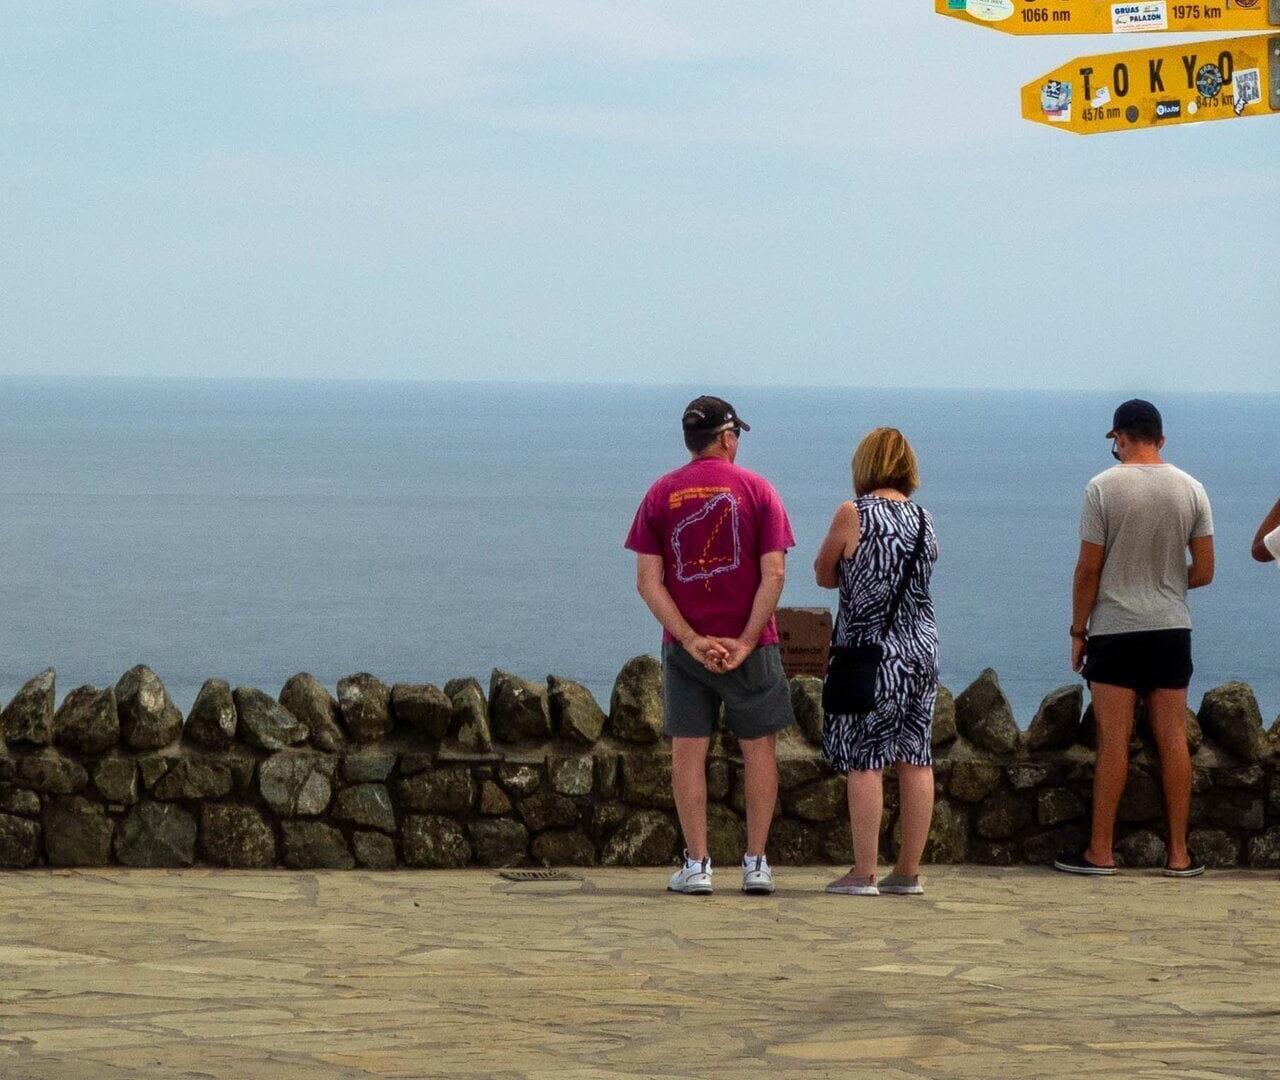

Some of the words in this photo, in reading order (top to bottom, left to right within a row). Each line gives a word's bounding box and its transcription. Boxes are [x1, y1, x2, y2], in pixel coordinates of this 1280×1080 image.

[1021, 8, 1049, 23] 1066
[1052, 9, 1071, 22] nm
[1172, 5, 1200, 19] 1975
[1204, 5, 1222, 19] km
[1080, 50, 1233, 101] TOKYO
[1082, 107, 1104, 122] 4576
[1106, 107, 1121, 119] nm
